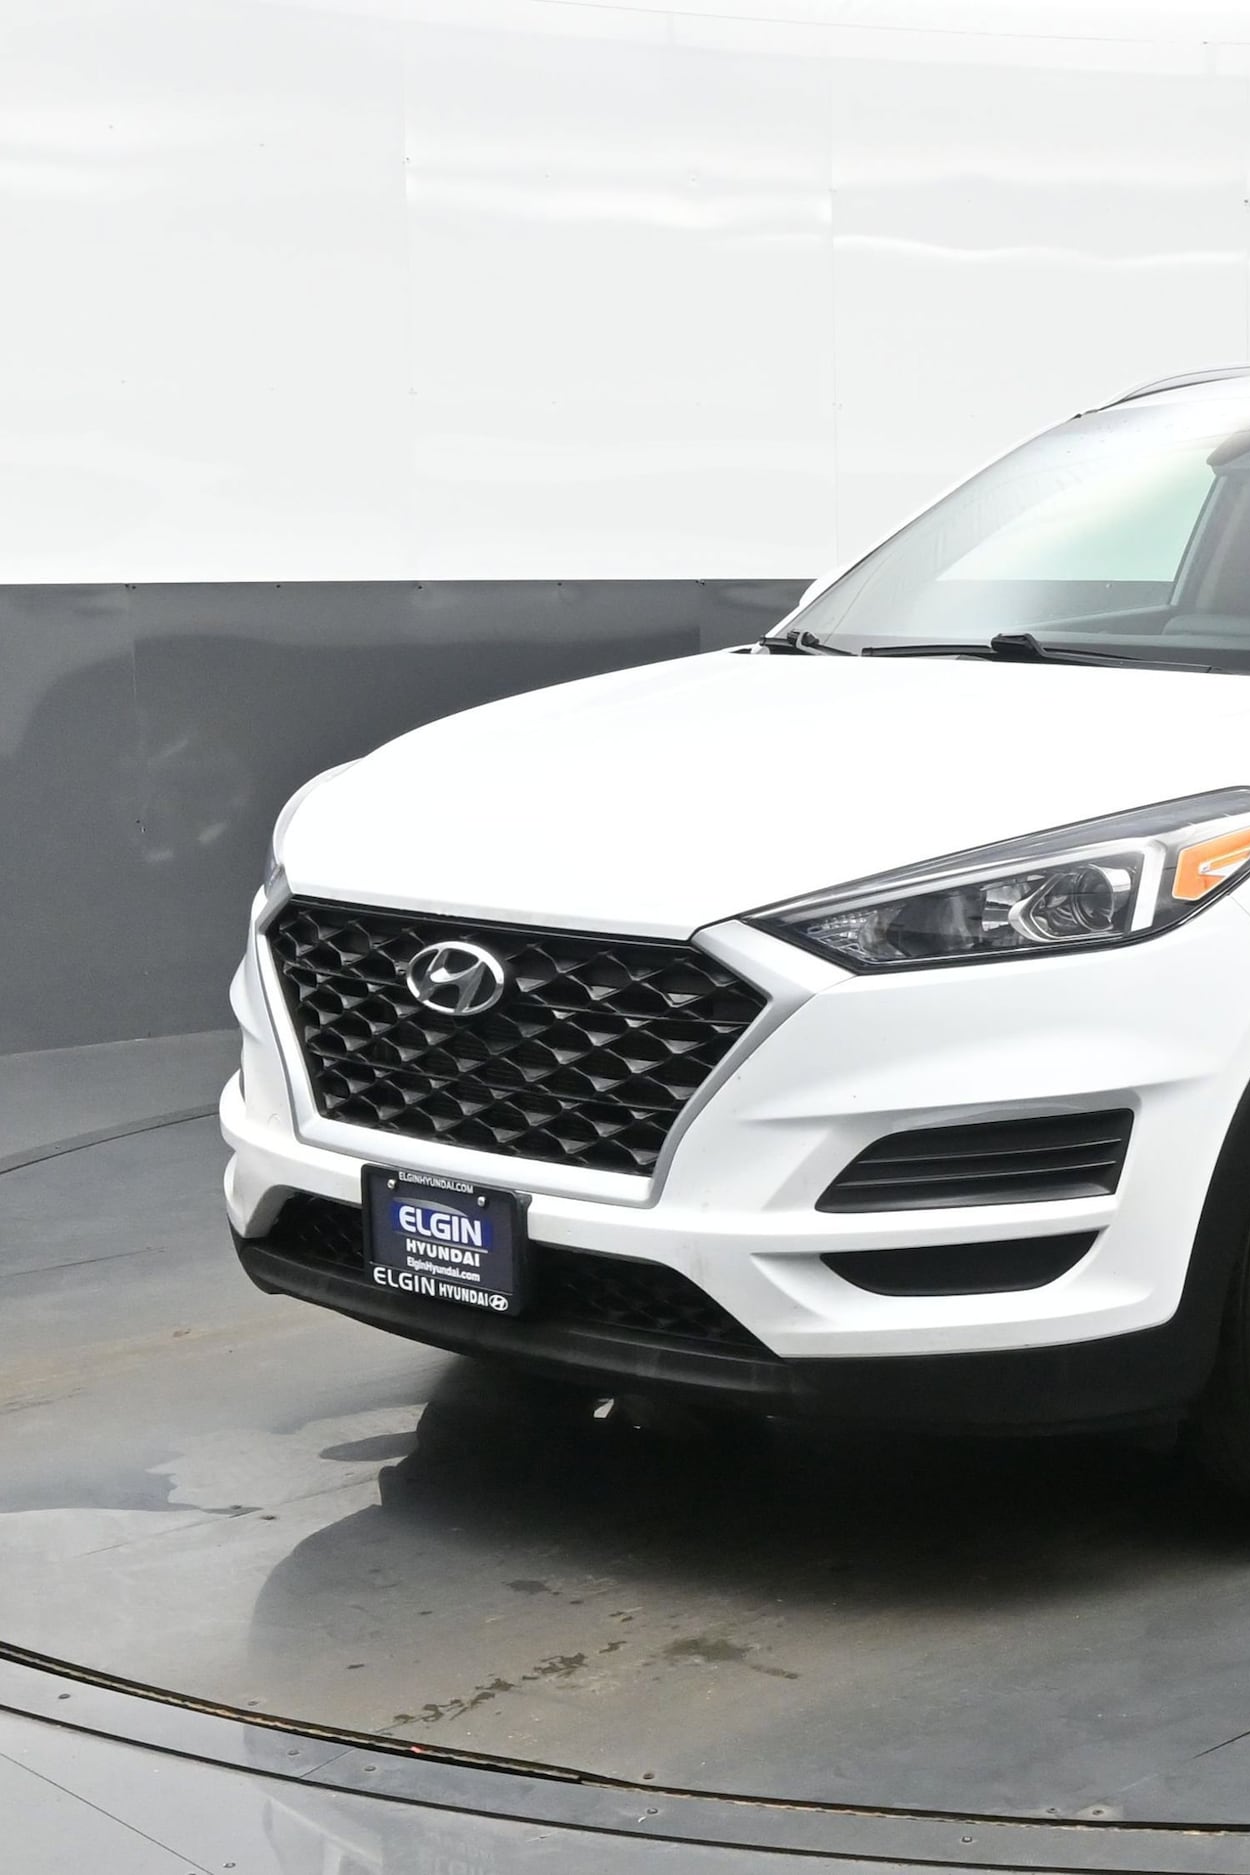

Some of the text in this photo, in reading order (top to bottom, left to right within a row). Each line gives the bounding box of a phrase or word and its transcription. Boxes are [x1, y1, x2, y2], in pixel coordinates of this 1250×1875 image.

[399, 1171, 474, 1194] ELGINHYUNDAI.COM
[399, 1205, 482, 1247] ELGIN
[406, 1238, 481, 1267] HYUNDAI
[407, 1256, 481, 1282] ElginHyundai.com
[373, 1266, 489, 1307] ELGIN HYUNDAI
